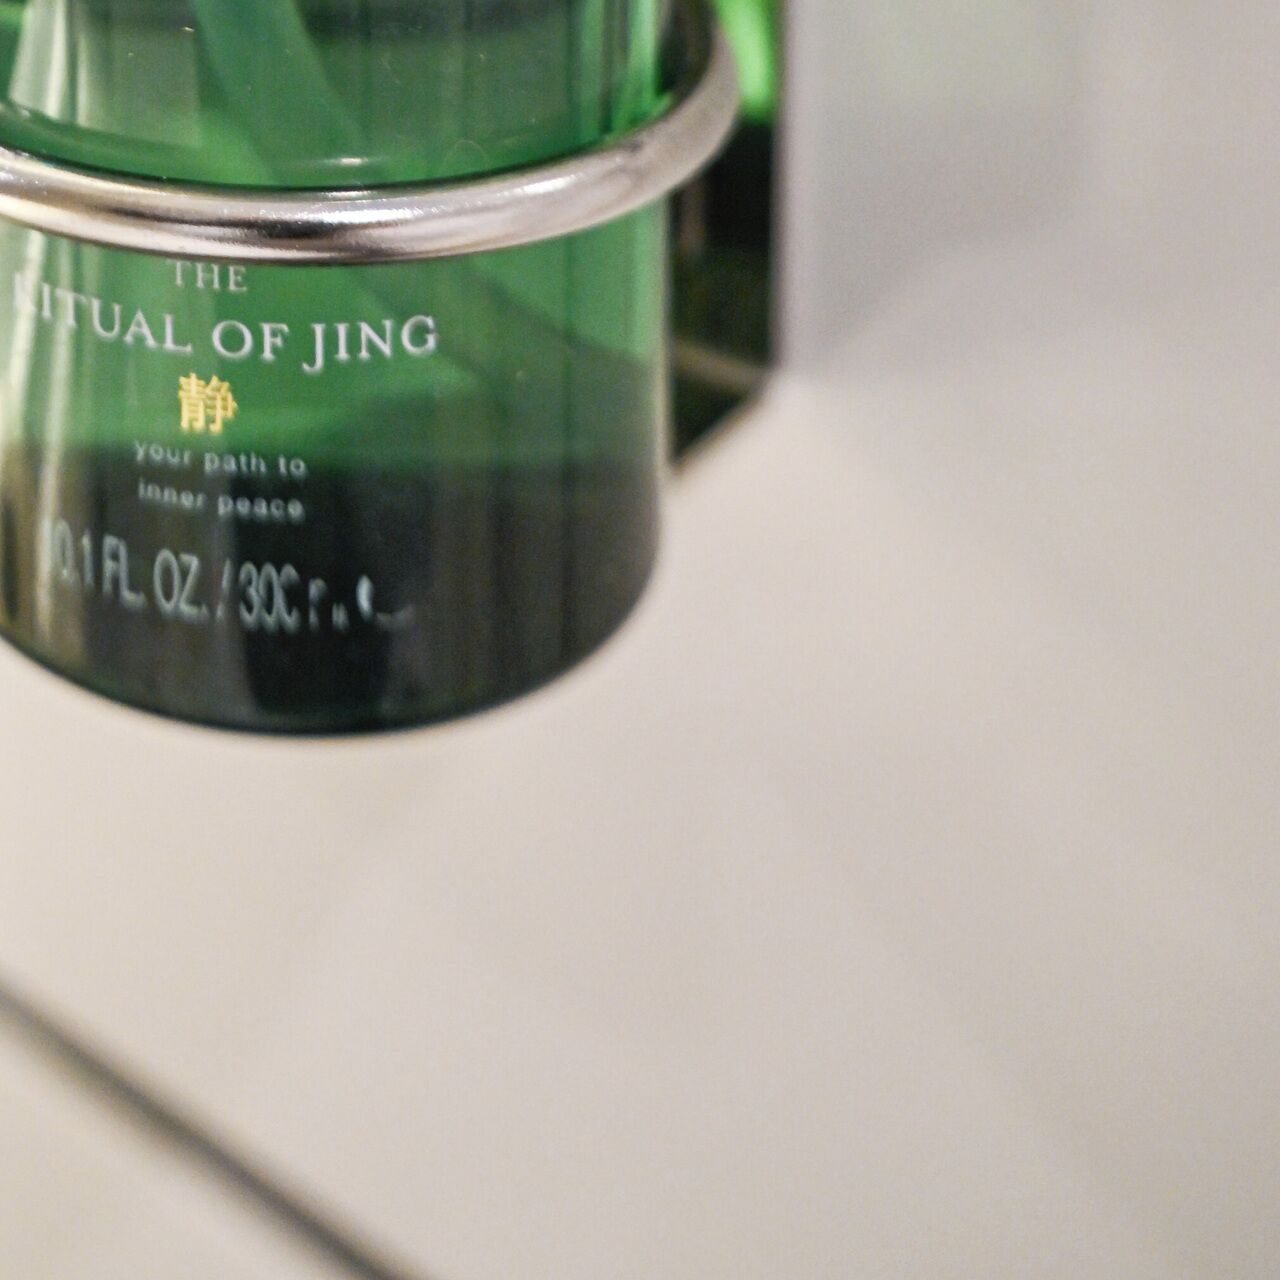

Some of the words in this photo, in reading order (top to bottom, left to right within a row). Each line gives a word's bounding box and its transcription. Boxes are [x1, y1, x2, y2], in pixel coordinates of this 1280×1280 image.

[167, 258, 250, 293] THE
[211, 319, 291, 362] OF
[302, 313, 440, 376] JING
[134, 441, 193, 467] your
[204, 451, 268, 478] path
[277, 453, 308, 479] to
[137, 476, 205, 511] inner
[217, 493, 305, 523] peace
